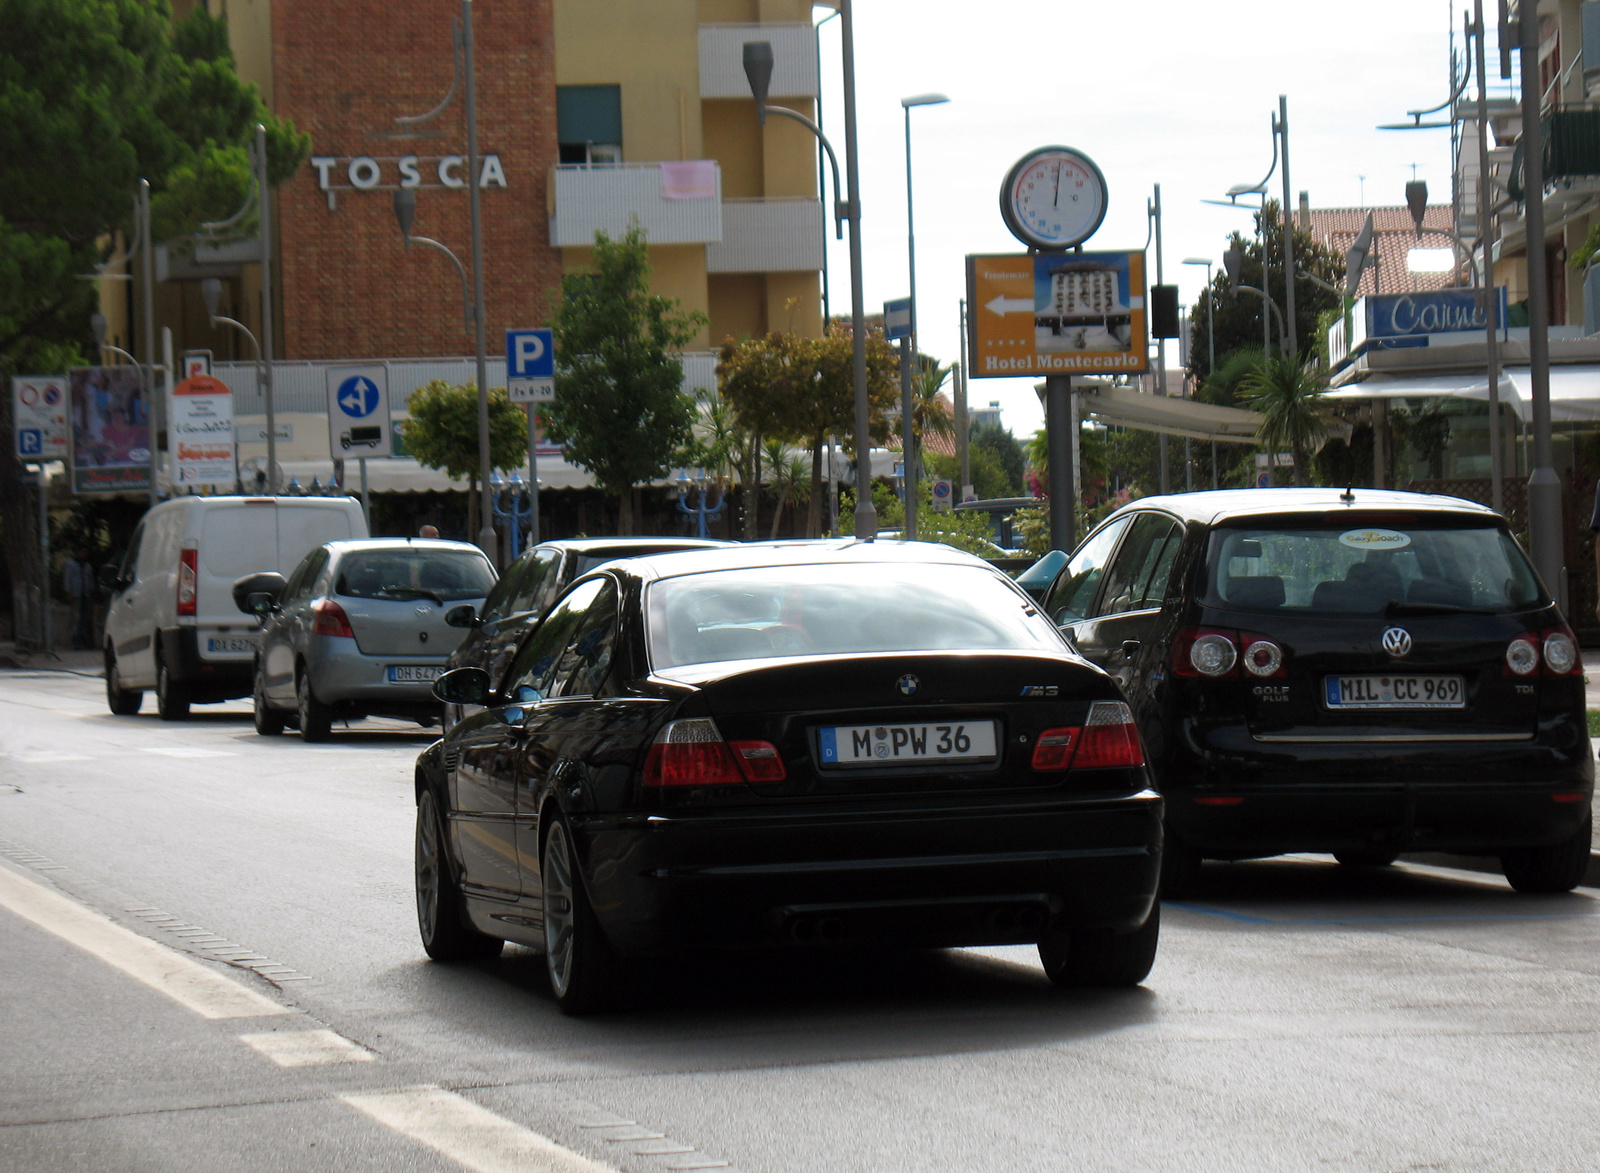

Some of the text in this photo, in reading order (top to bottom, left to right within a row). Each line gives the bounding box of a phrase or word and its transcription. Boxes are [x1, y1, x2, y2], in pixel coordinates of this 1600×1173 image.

[310, 154, 508, 190] TOSCA
[514, 335, 545, 374] P
[986, 352, 1139, 371] Hotel Montecarlo
[22, 431, 38, 452] P
[396, 667, 412, 680] DH
[1252, 686, 1290, 695] GOLF
[1340, 678, 1459, 701] MIL CC 969
[1514, 685, 1534, 694] TDI
[852, 725, 971, 758] M PW 36
[825, 748, 833, 757] D
